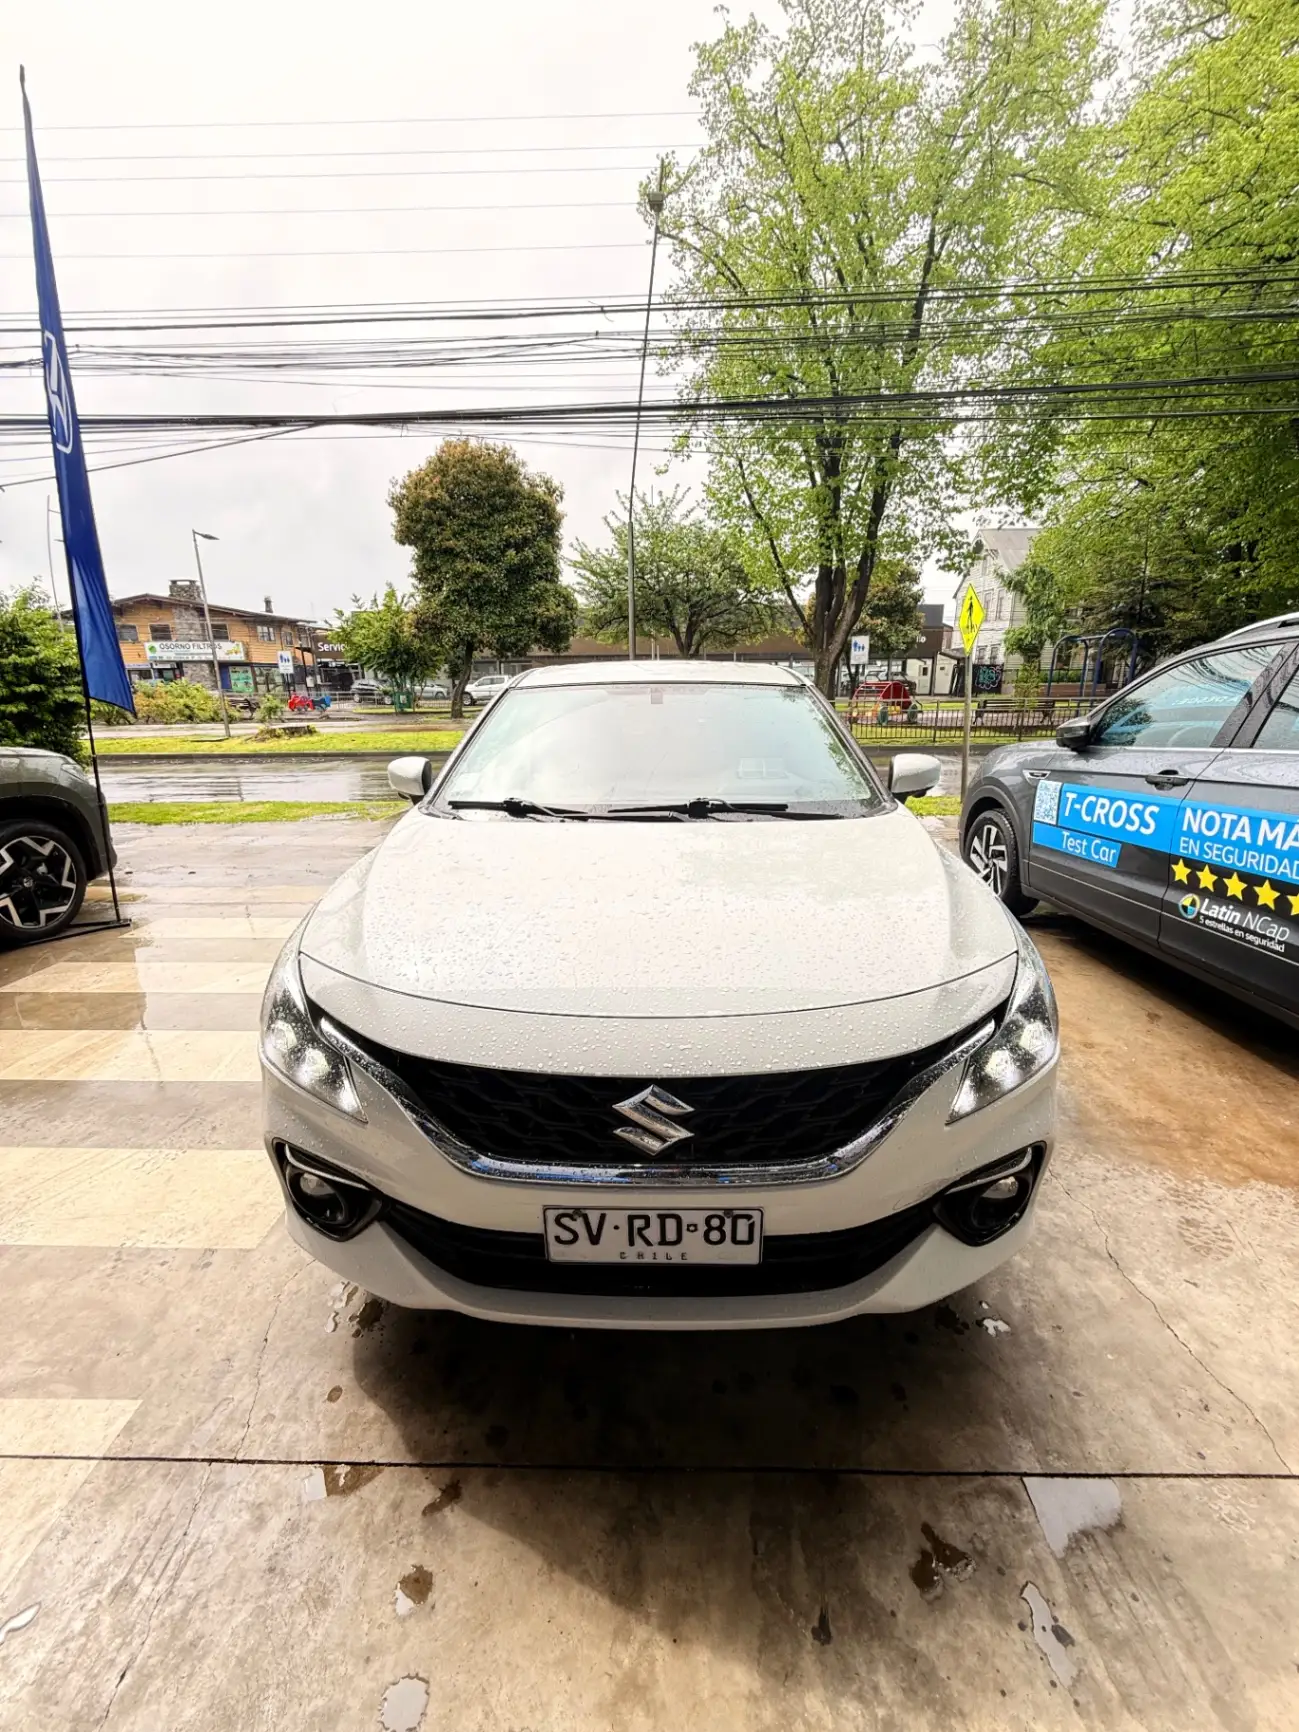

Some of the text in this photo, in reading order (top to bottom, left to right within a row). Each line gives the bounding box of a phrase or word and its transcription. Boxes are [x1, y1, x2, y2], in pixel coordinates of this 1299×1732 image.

[159, 642, 191, 650] OSORNO
[1064, 792, 1160, 835] T-CROSS
[1182, 807, 1252, 844] NOTA
[1062, 831, 1117, 863] Test Car
[1179, 836, 1200, 857] EN
[1199, 915, 1285, 953] 5 estrellas en seguridad
[1200, 898, 1291, 943] Latin NCap
[619, 1251, 688, 1261] CHILE
